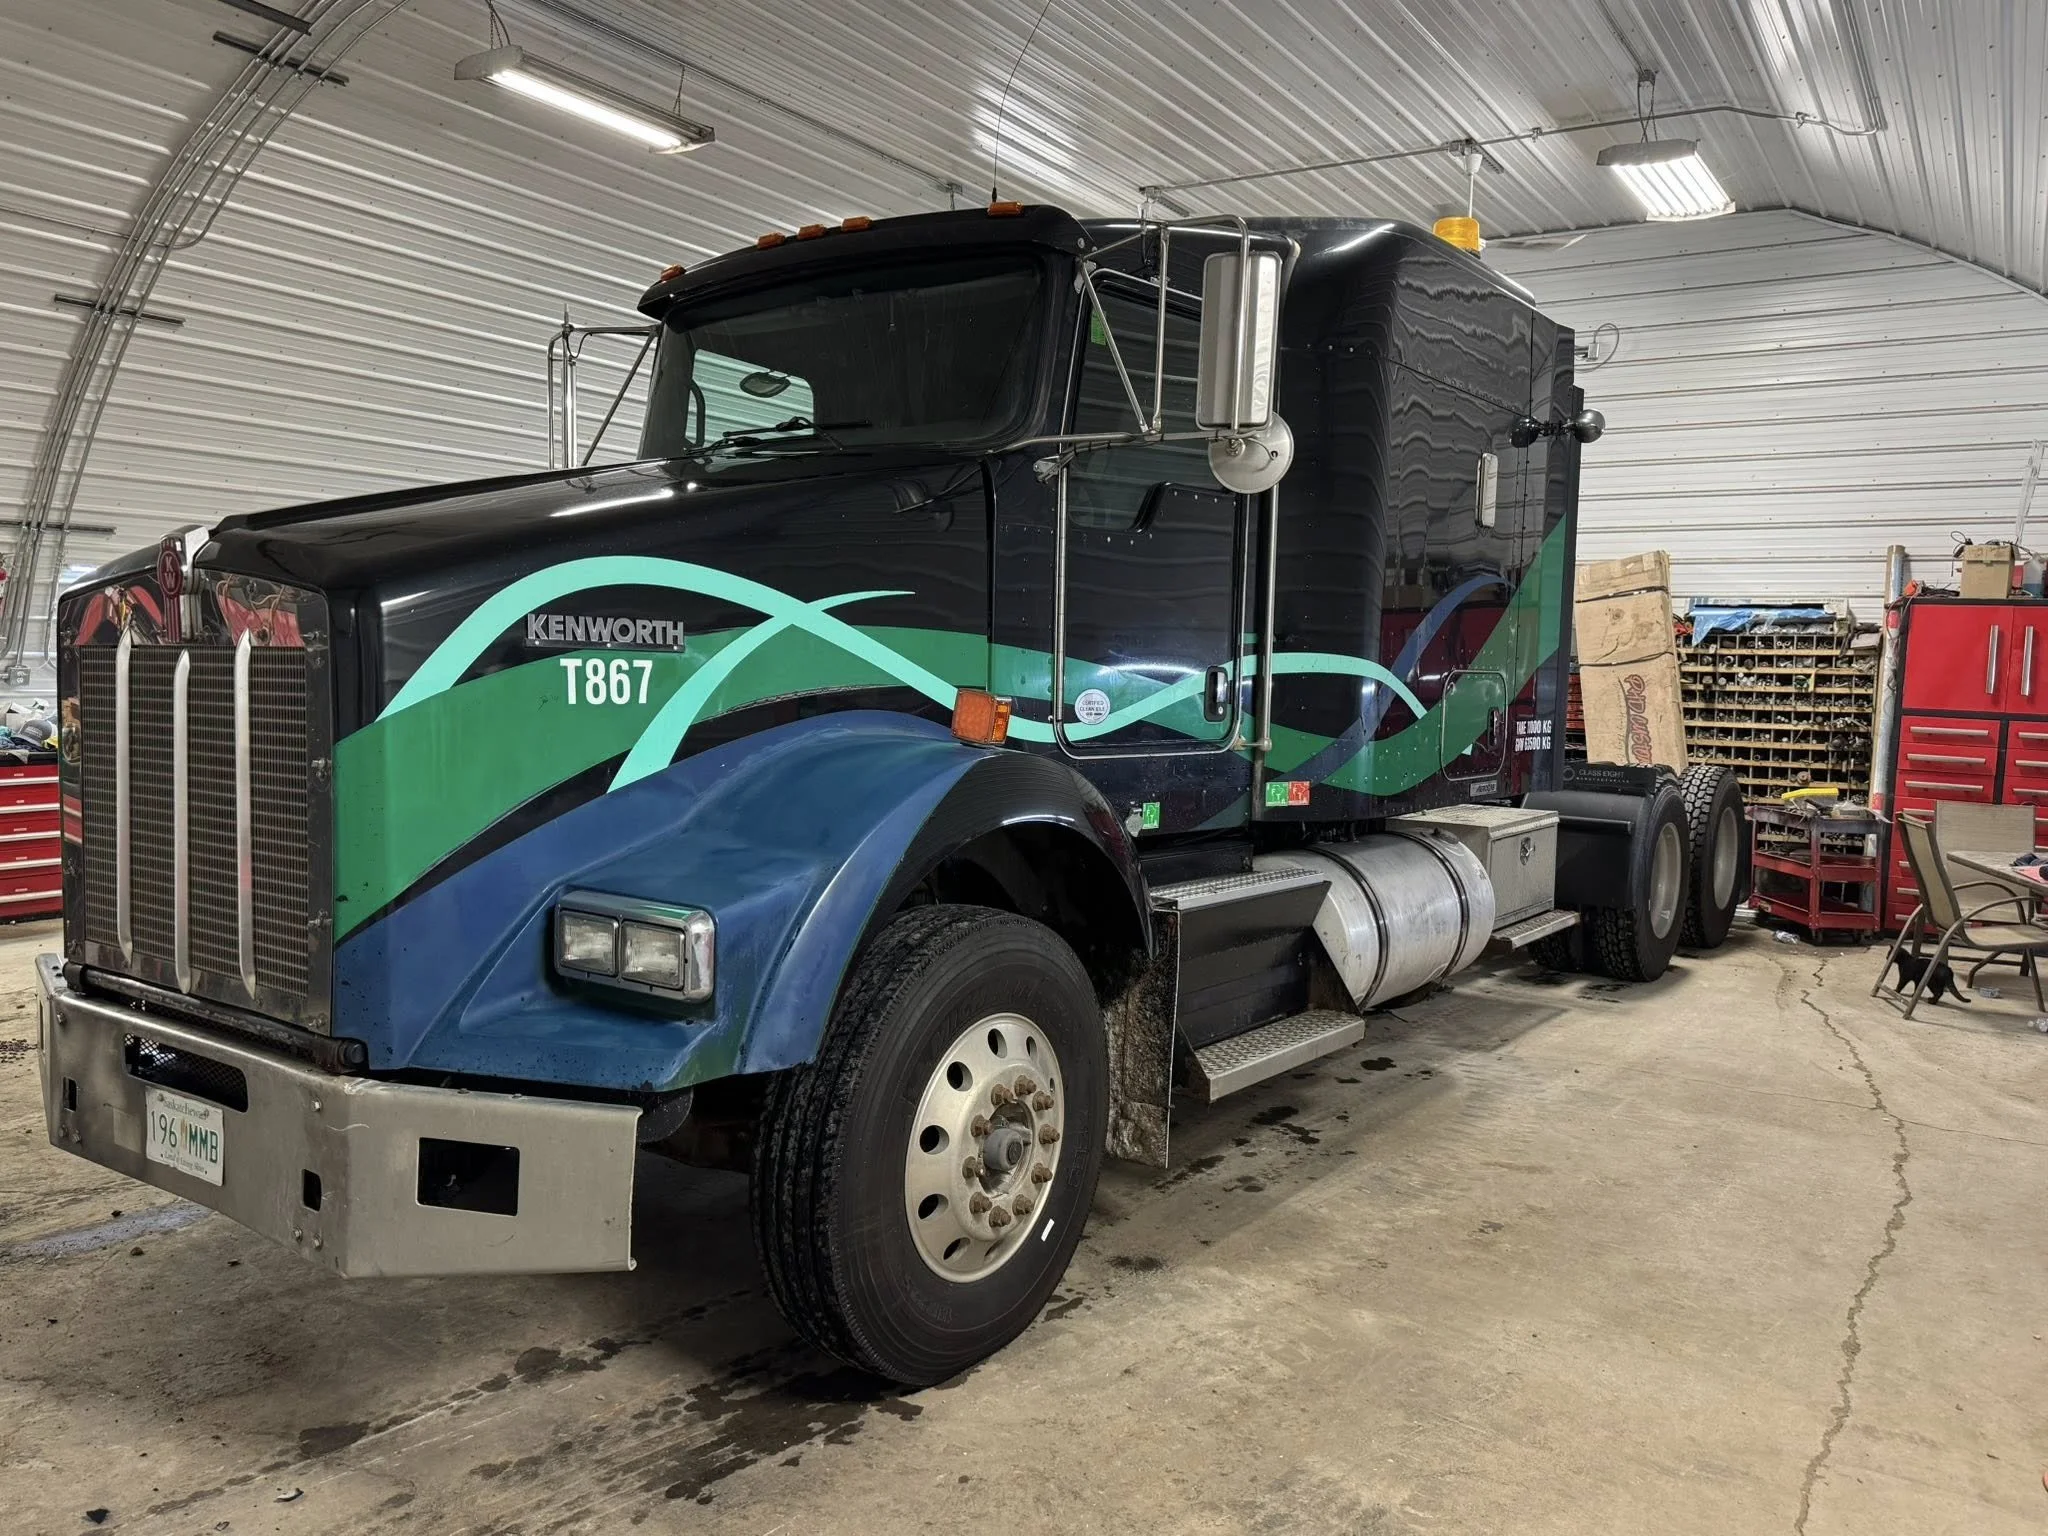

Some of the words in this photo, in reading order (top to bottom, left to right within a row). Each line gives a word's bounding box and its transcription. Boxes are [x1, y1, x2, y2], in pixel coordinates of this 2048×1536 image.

[527, 613, 684, 646] KENWORTH
[559, 658, 653, 705] T867
[1542, 719, 1552, 734] KG
[1541, 736, 1551, 750] KG
[1578, 769, 1602, 777] CLASS
[1602, 770, 1625, 778] EIGHT
[151, 1110, 178, 1148] 196
[188, 1122, 218, 1164] MMB
